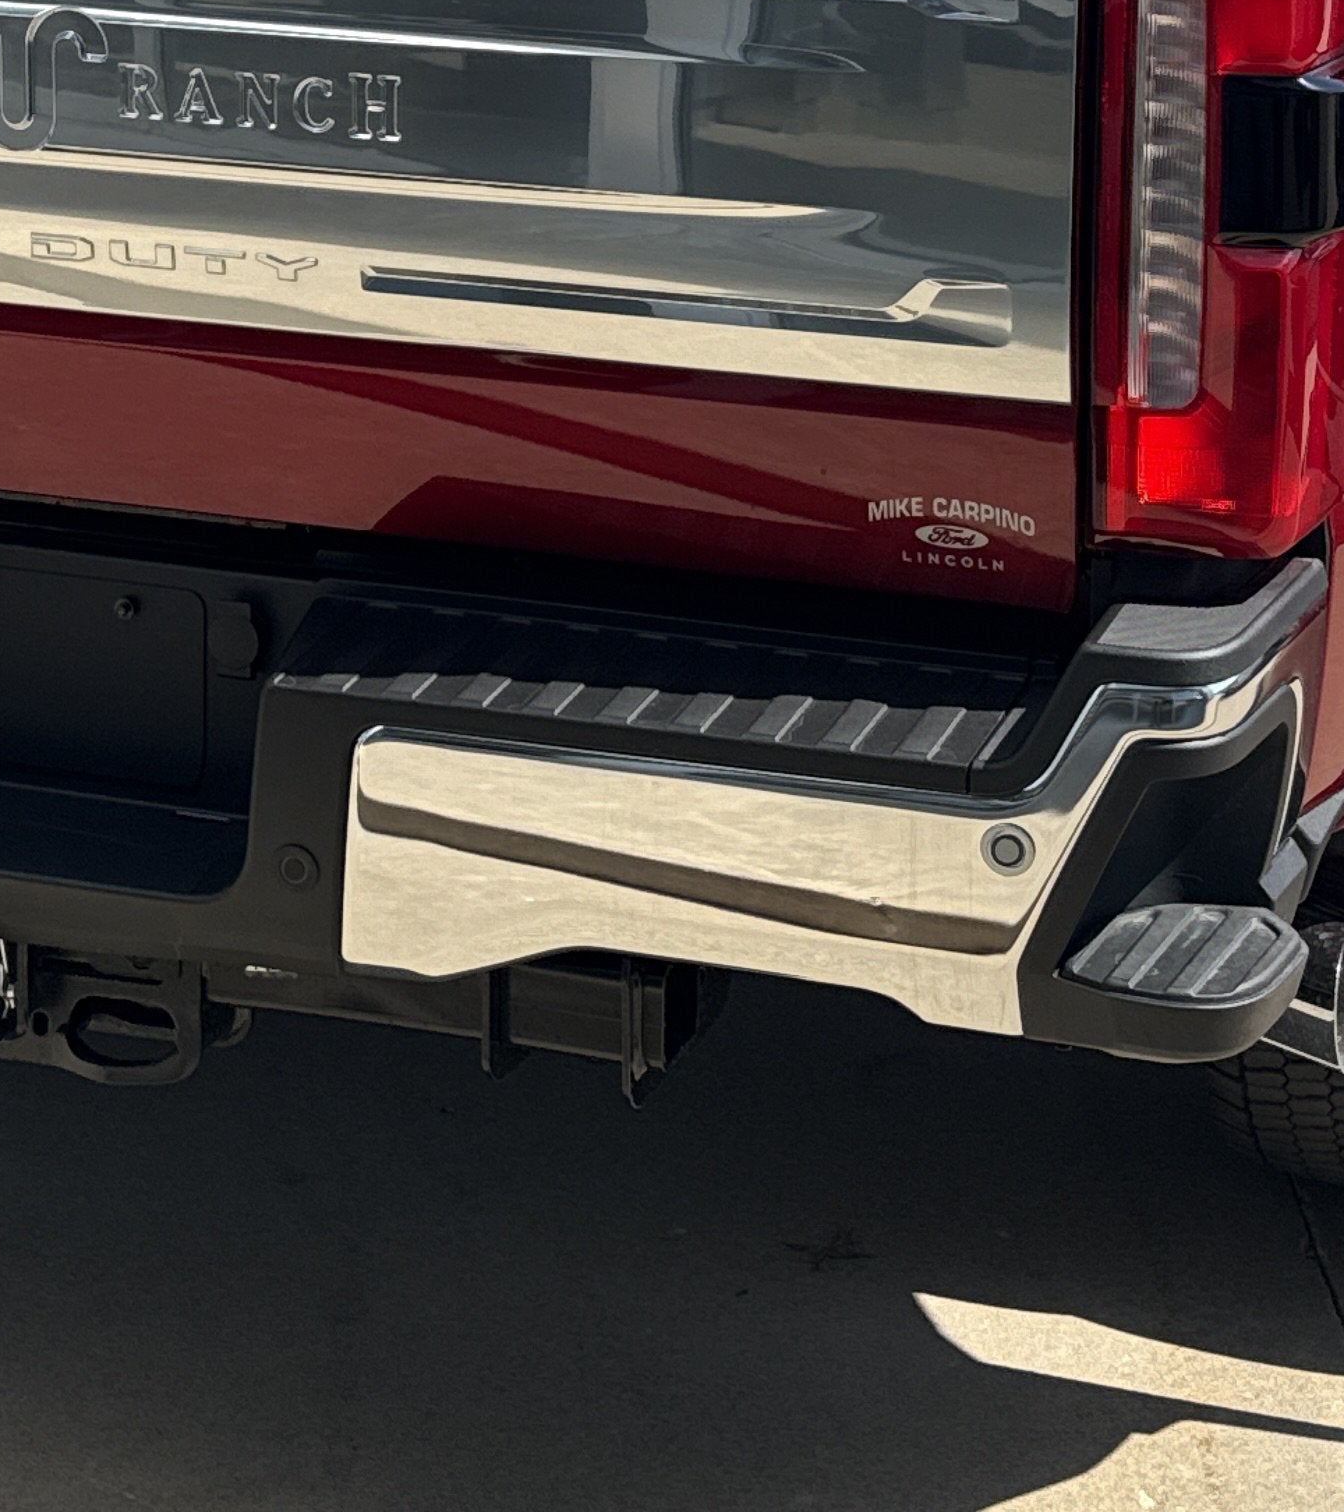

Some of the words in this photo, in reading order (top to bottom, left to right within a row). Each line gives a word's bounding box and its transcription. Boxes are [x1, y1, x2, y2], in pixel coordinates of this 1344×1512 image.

[117, 62, 402, 142] RANCH
[30, 231, 318, 282] DUTY
[867, 496, 924, 522] MIKE
[932, 496, 1036, 537] CARPINO
[927, 526, 977, 547] Ford
[902, 550, 1004, 571] LINCOLN
